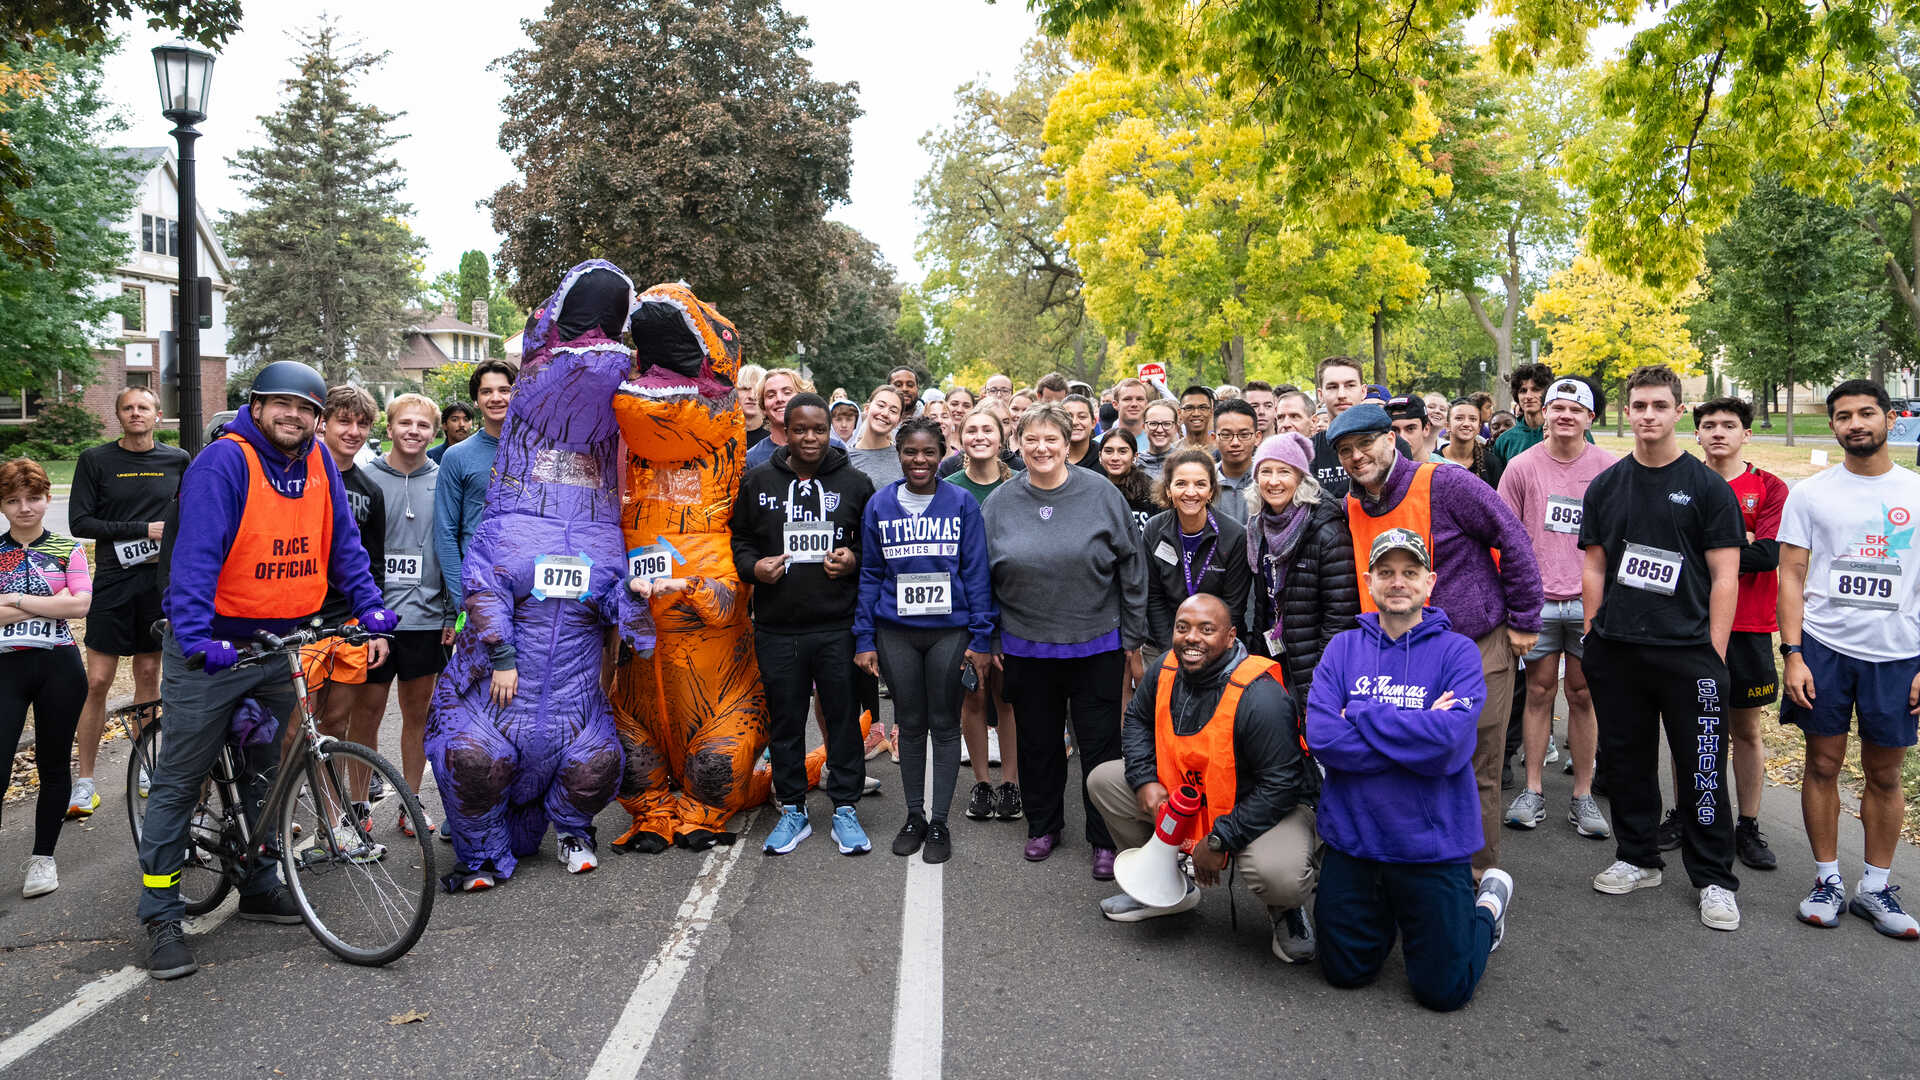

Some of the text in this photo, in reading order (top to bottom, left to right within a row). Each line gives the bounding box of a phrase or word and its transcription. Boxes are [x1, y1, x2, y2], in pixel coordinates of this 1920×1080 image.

[1318, 467, 1334, 479] ST.
[892, 516, 961, 543] THOMAS
[273, 537, 309, 556] RACE
[789, 534, 829, 552] 8800
[1866, 535, 1889, 545] 5K
[123, 540, 159, 559] 8784
[885, 546, 929, 557] TOMMIES
[1860, 547, 1889, 558] 10K
[255, 558, 318, 579] OFFICIAL
[384, 558, 417, 575] 943
[634, 556, 666, 577] 8796
[1626, 557, 1674, 583] 8859
[544, 568, 582, 587] 8776
[1838, 575, 1893, 598] 8979
[904, 586, 944, 604] 8872
[3, 621, 51, 638] 8964
[1747, 683, 1775, 698] ARMY
[1694, 678, 1720, 825] ST. THOMAS
